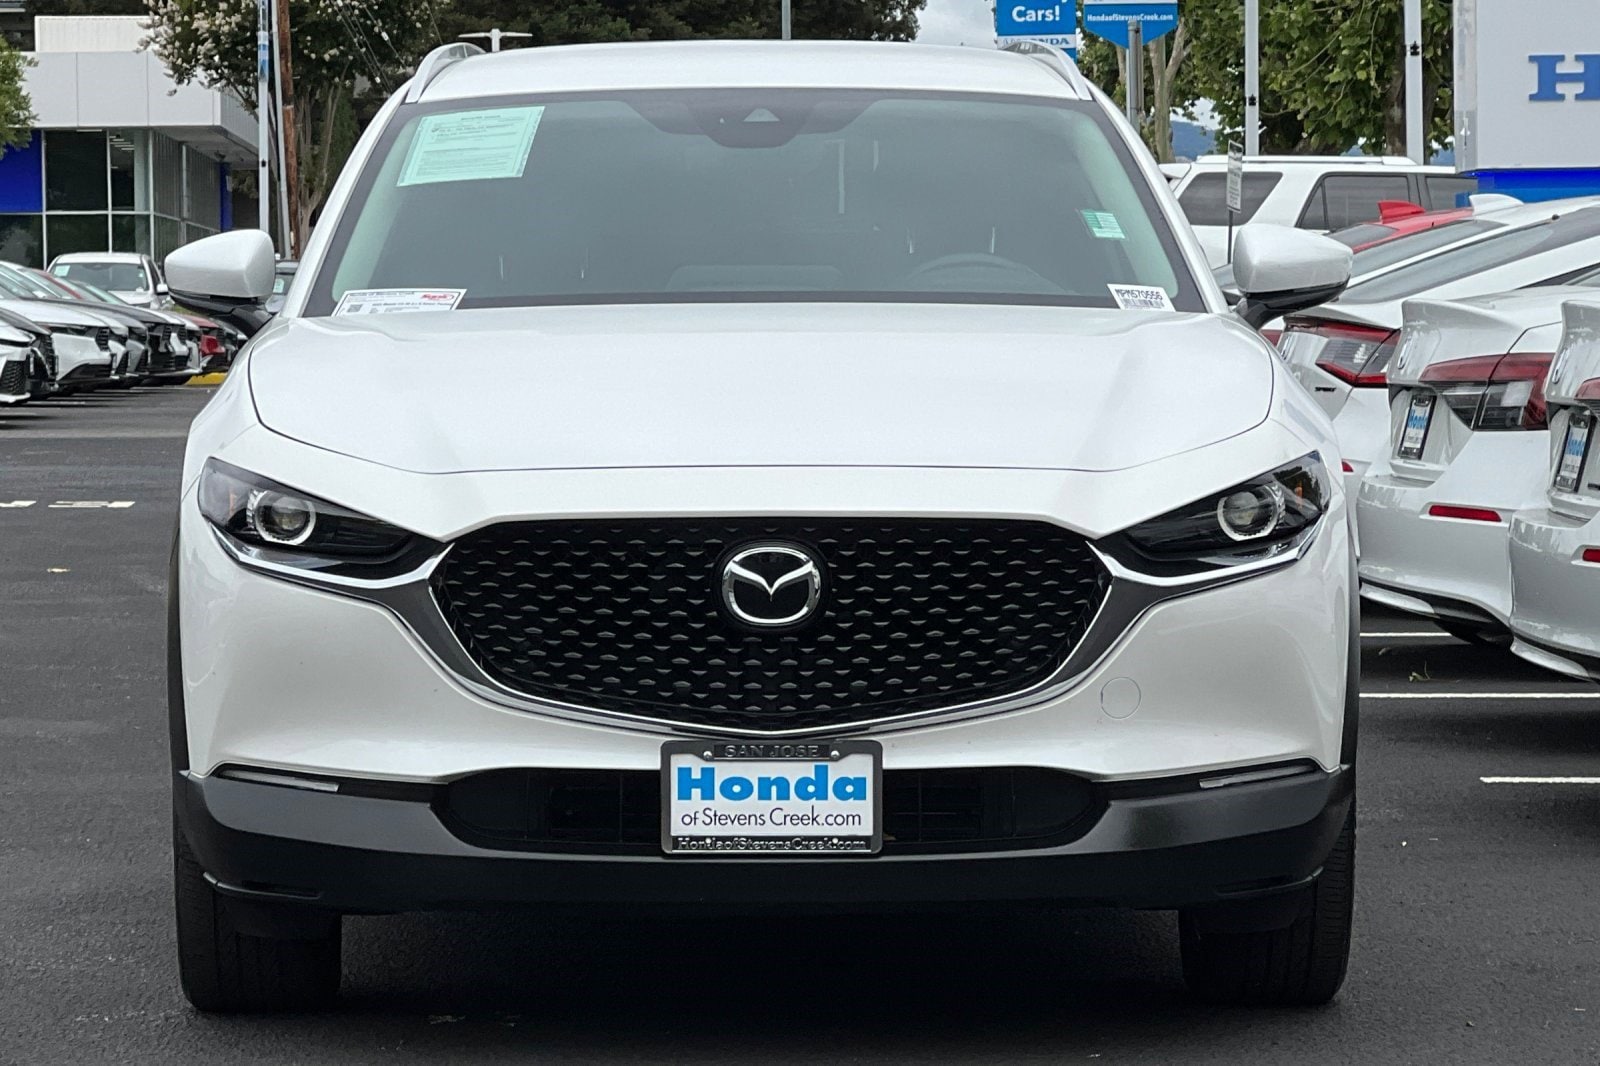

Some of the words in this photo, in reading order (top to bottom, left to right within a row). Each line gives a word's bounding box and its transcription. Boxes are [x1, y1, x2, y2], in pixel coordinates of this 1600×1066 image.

[1011, 5, 1060, 22] Cars!
[1087, 13, 1174, 21] HondaofStevensCreek.com
[724, 745, 764, 758] SAN
[769, 745, 819, 758] JOSE
[677, 764, 867, 801] Honda
[681, 810, 700, 826] of
[702, 807, 766, 826] Stevens
[769, 805, 862, 826] Creek.com
[677, 837, 866, 850] HondaofStevensCreek.com
